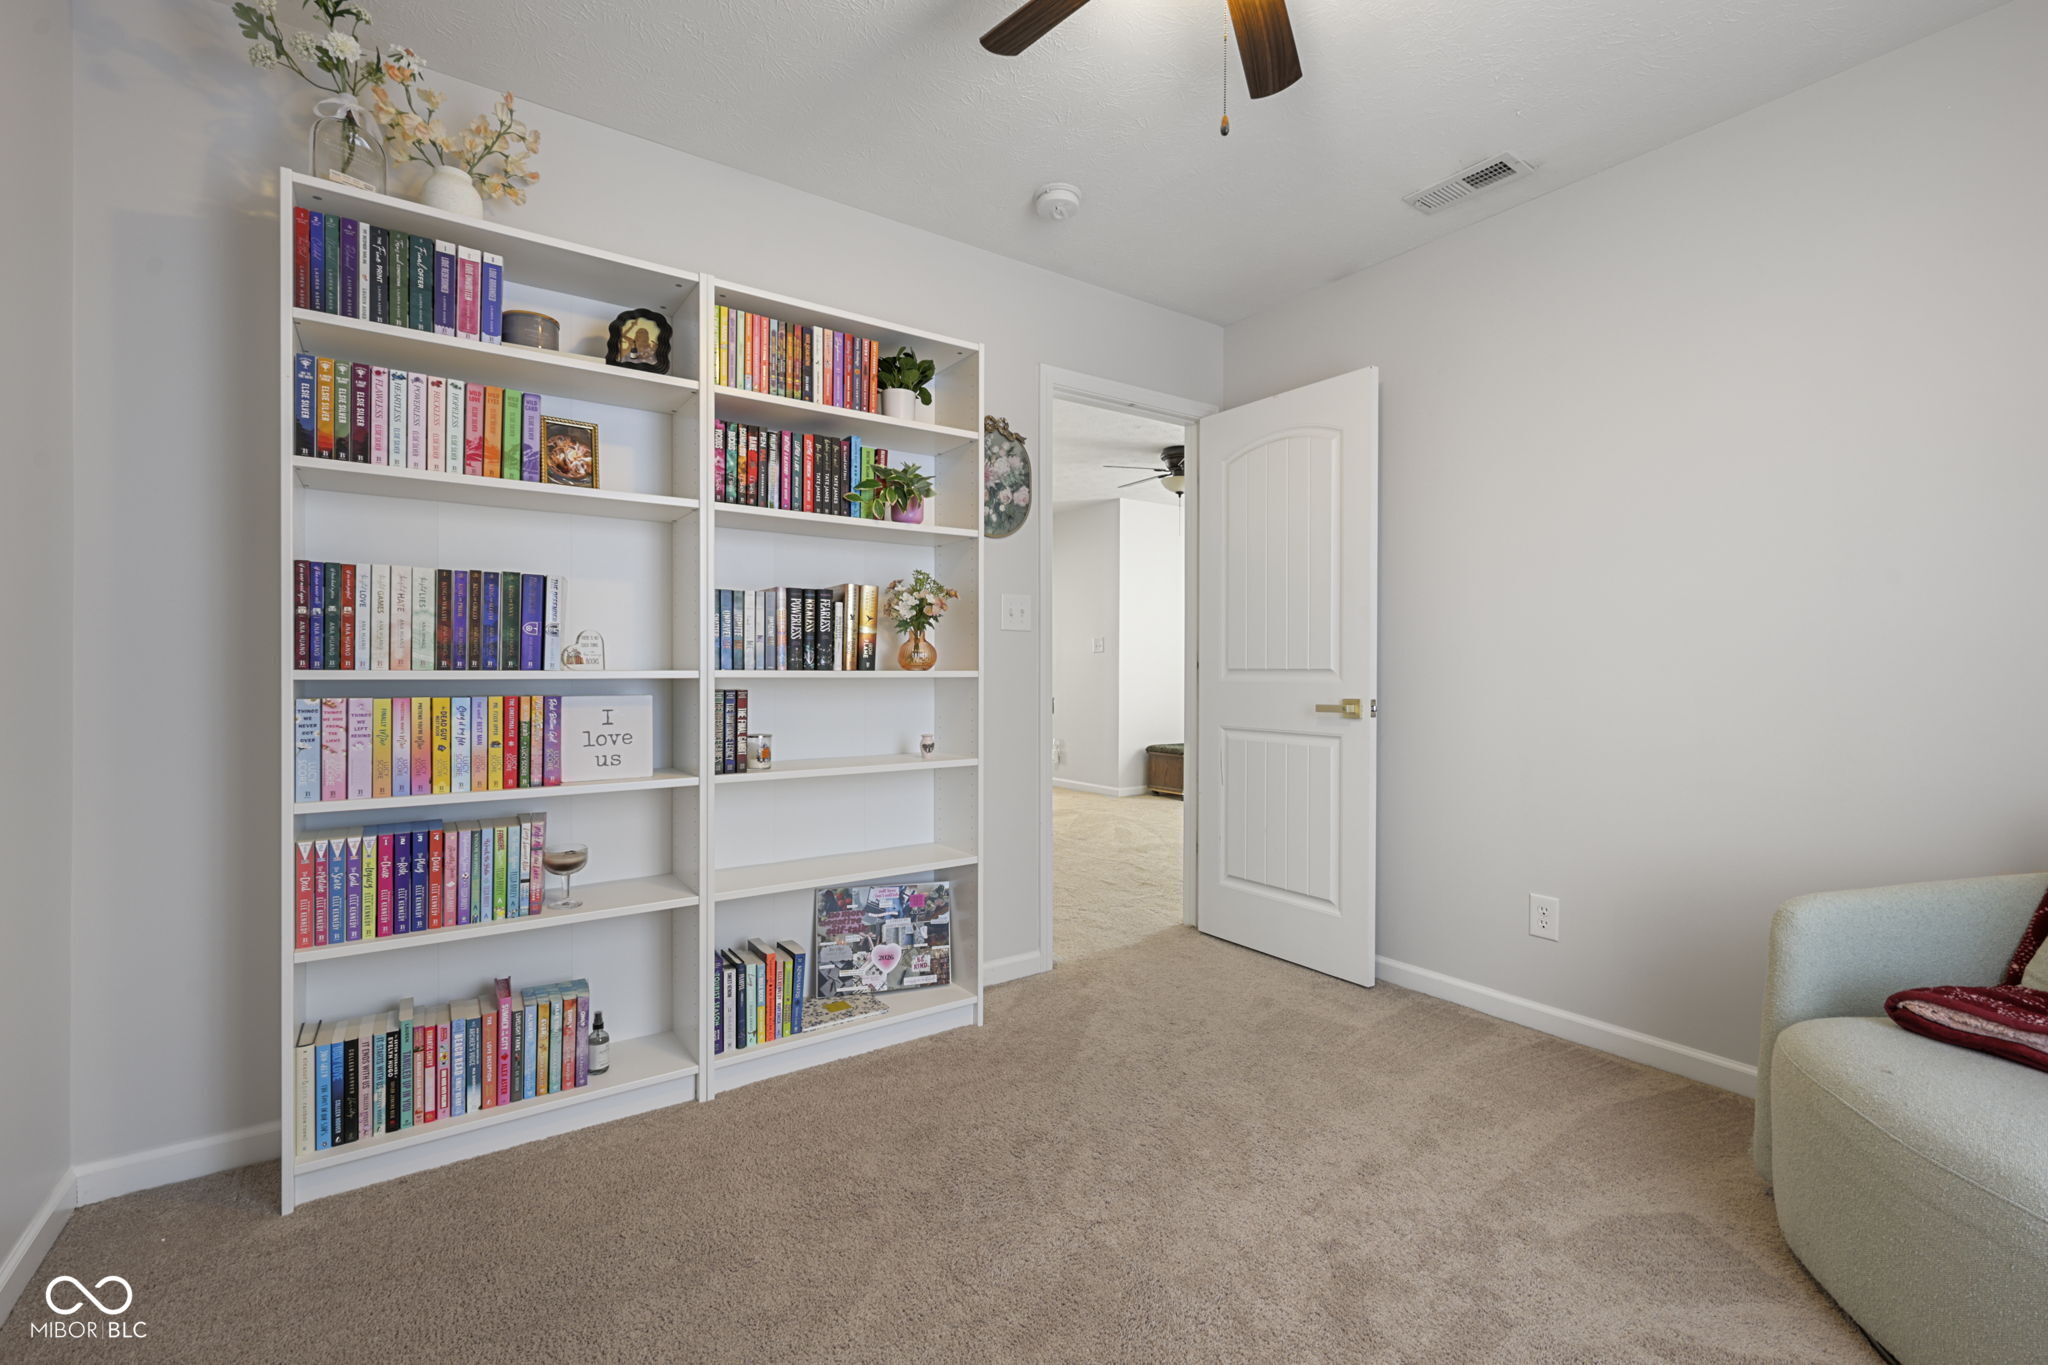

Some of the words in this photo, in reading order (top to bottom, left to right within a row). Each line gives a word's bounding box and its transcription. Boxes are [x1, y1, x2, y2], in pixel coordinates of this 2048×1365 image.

[414, 245, 428, 270] Final
[321, 386, 330, 400] ELSIE
[356, 392, 364, 406] ELSIE
[375, 379, 383, 418] FLAWLESS
[301, 400, 310, 418] SILVER
[338, 404, 347, 423] SILVER
[356, 408, 365, 427] SILVER
[722, 610, 730, 637] UNRAVEL
[791, 598, 801, 639] POWERLESS
[805, 599, 815, 632] RECKLESS
[820, 599, 830, 632] FEARLESS
[734, 614, 742, 637] IGNITE
[723, 640, 730, 648] ME
[602, 709, 614, 725] I
[738, 708, 746, 718] THE
[738, 720, 746, 734] FINAL
[582, 730, 633, 748] love
[594, 754, 622, 766] us
[454, 1033, 462, 1056] BEACH
[332, 1045, 343, 1064] UGLY
[332, 1065, 343, 1081] LOVE
[402, 1051, 411, 1079] TANGLED
[376, 1081, 383, 1089] US
[402, 1080, 410, 1088] UP
[403, 1090, 410, 1098] IN
